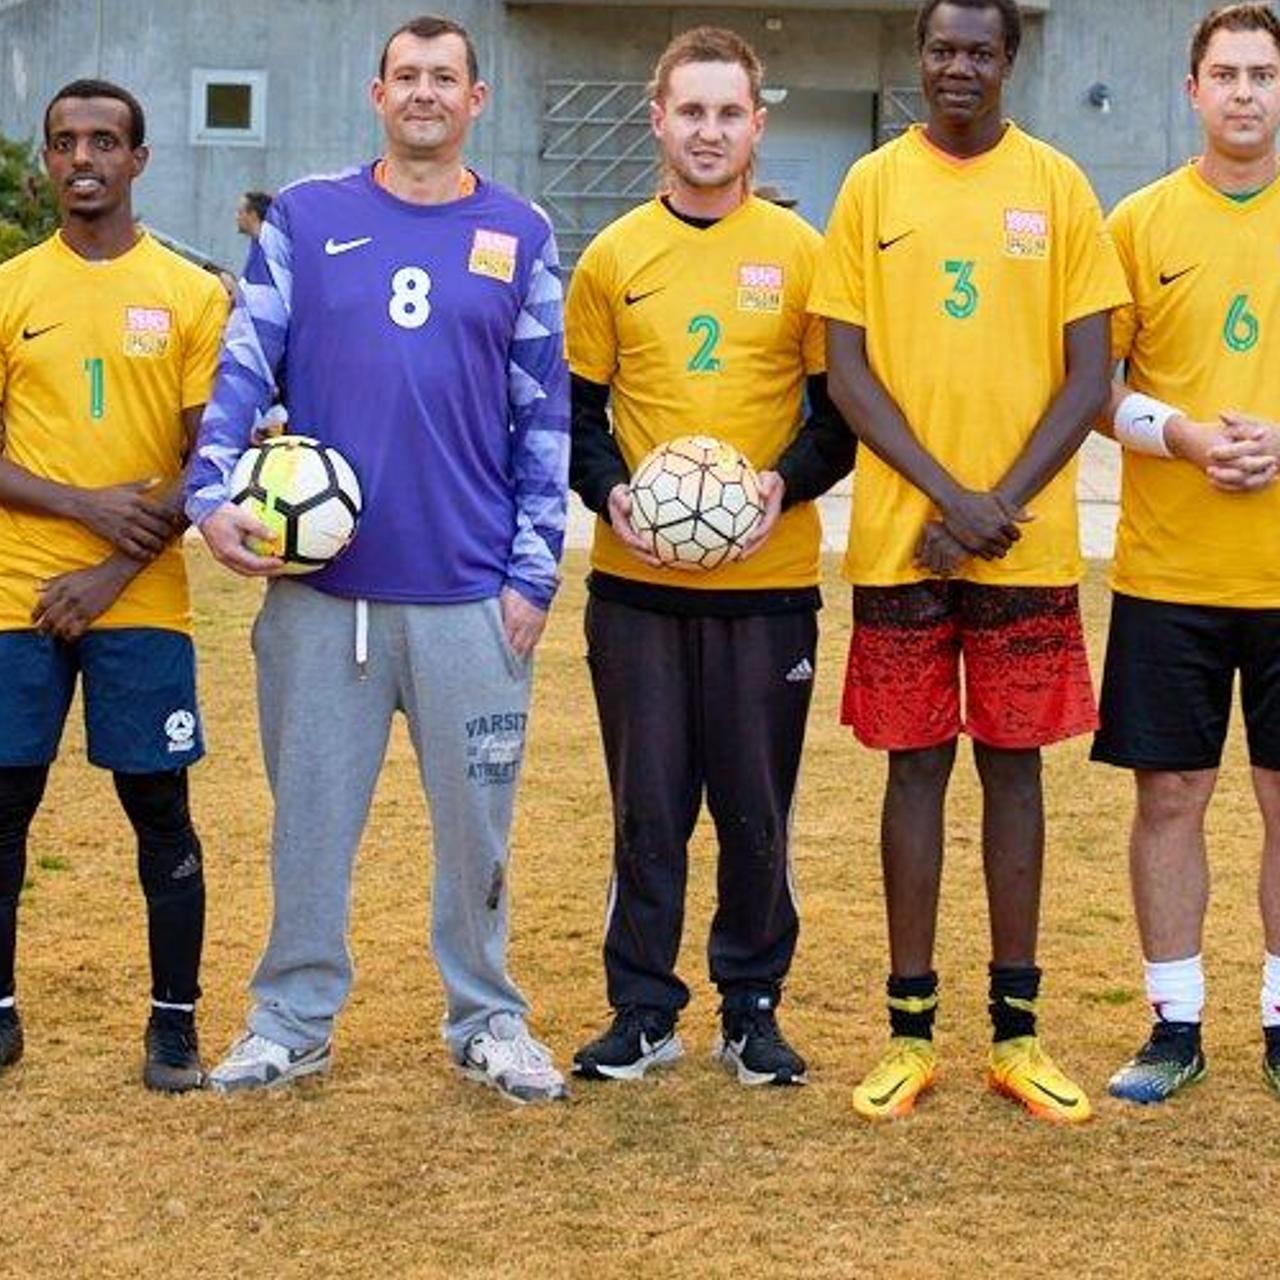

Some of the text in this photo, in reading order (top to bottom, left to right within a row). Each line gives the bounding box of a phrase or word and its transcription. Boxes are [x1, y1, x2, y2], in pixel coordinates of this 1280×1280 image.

[389, 266, 431, 328] 8
[944, 260, 978, 320] 3
[687, 315, 721, 372] 2
[1223, 294, 1259, 352] 6
[83, 358, 104, 419] 1
